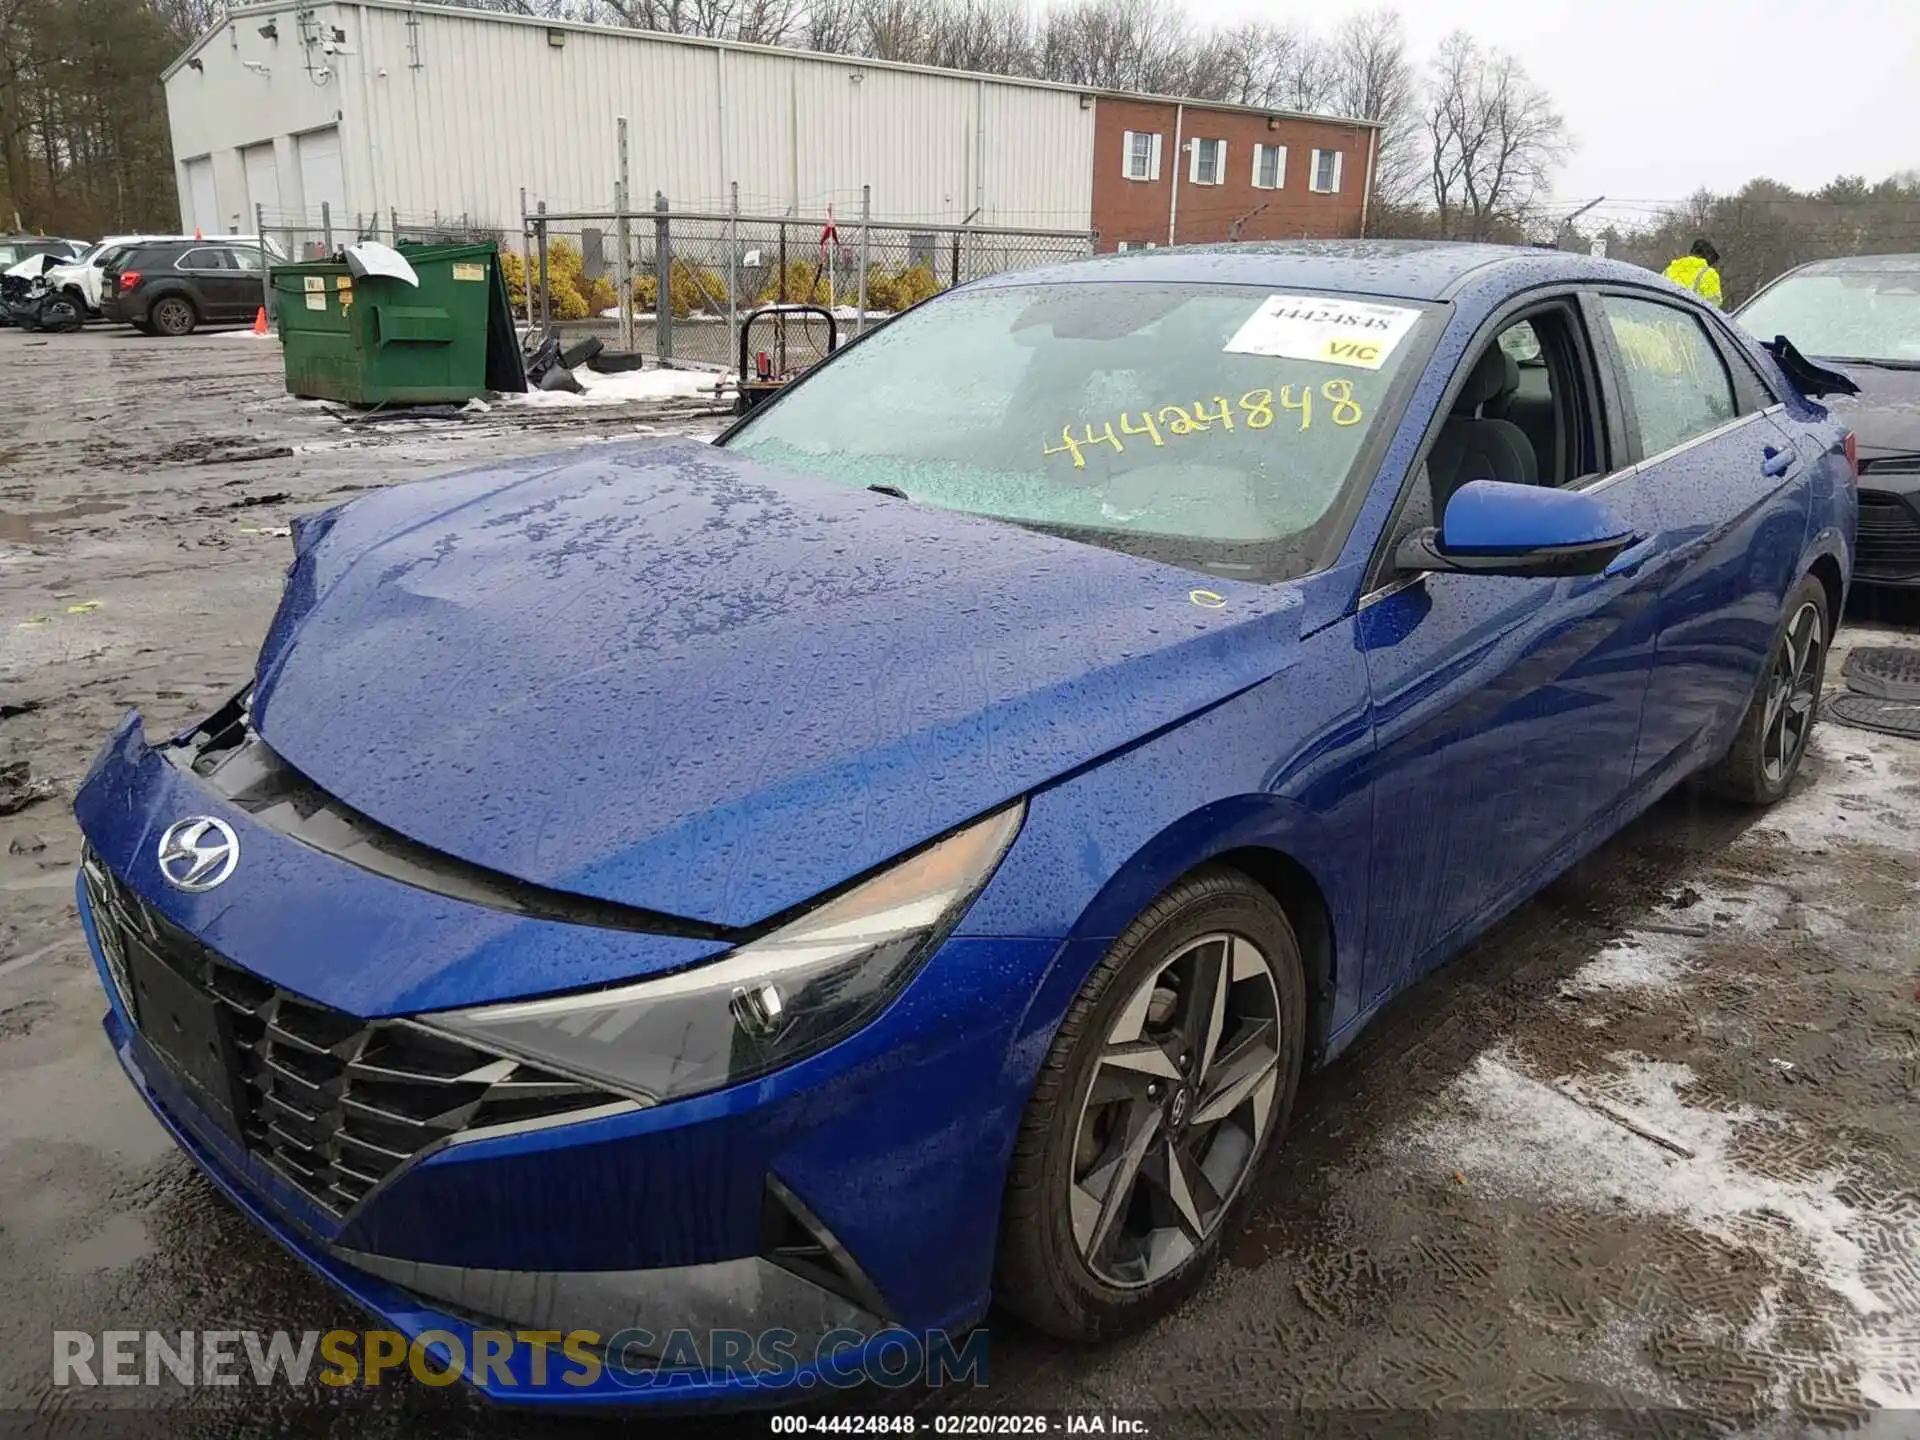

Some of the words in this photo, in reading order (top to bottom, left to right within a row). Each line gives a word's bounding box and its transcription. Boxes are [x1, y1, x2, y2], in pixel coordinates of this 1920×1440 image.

[1269, 308, 1391, 331] 44424848
[1330, 341, 1379, 360] VIC
[1043, 379, 1363, 469] 44424848
